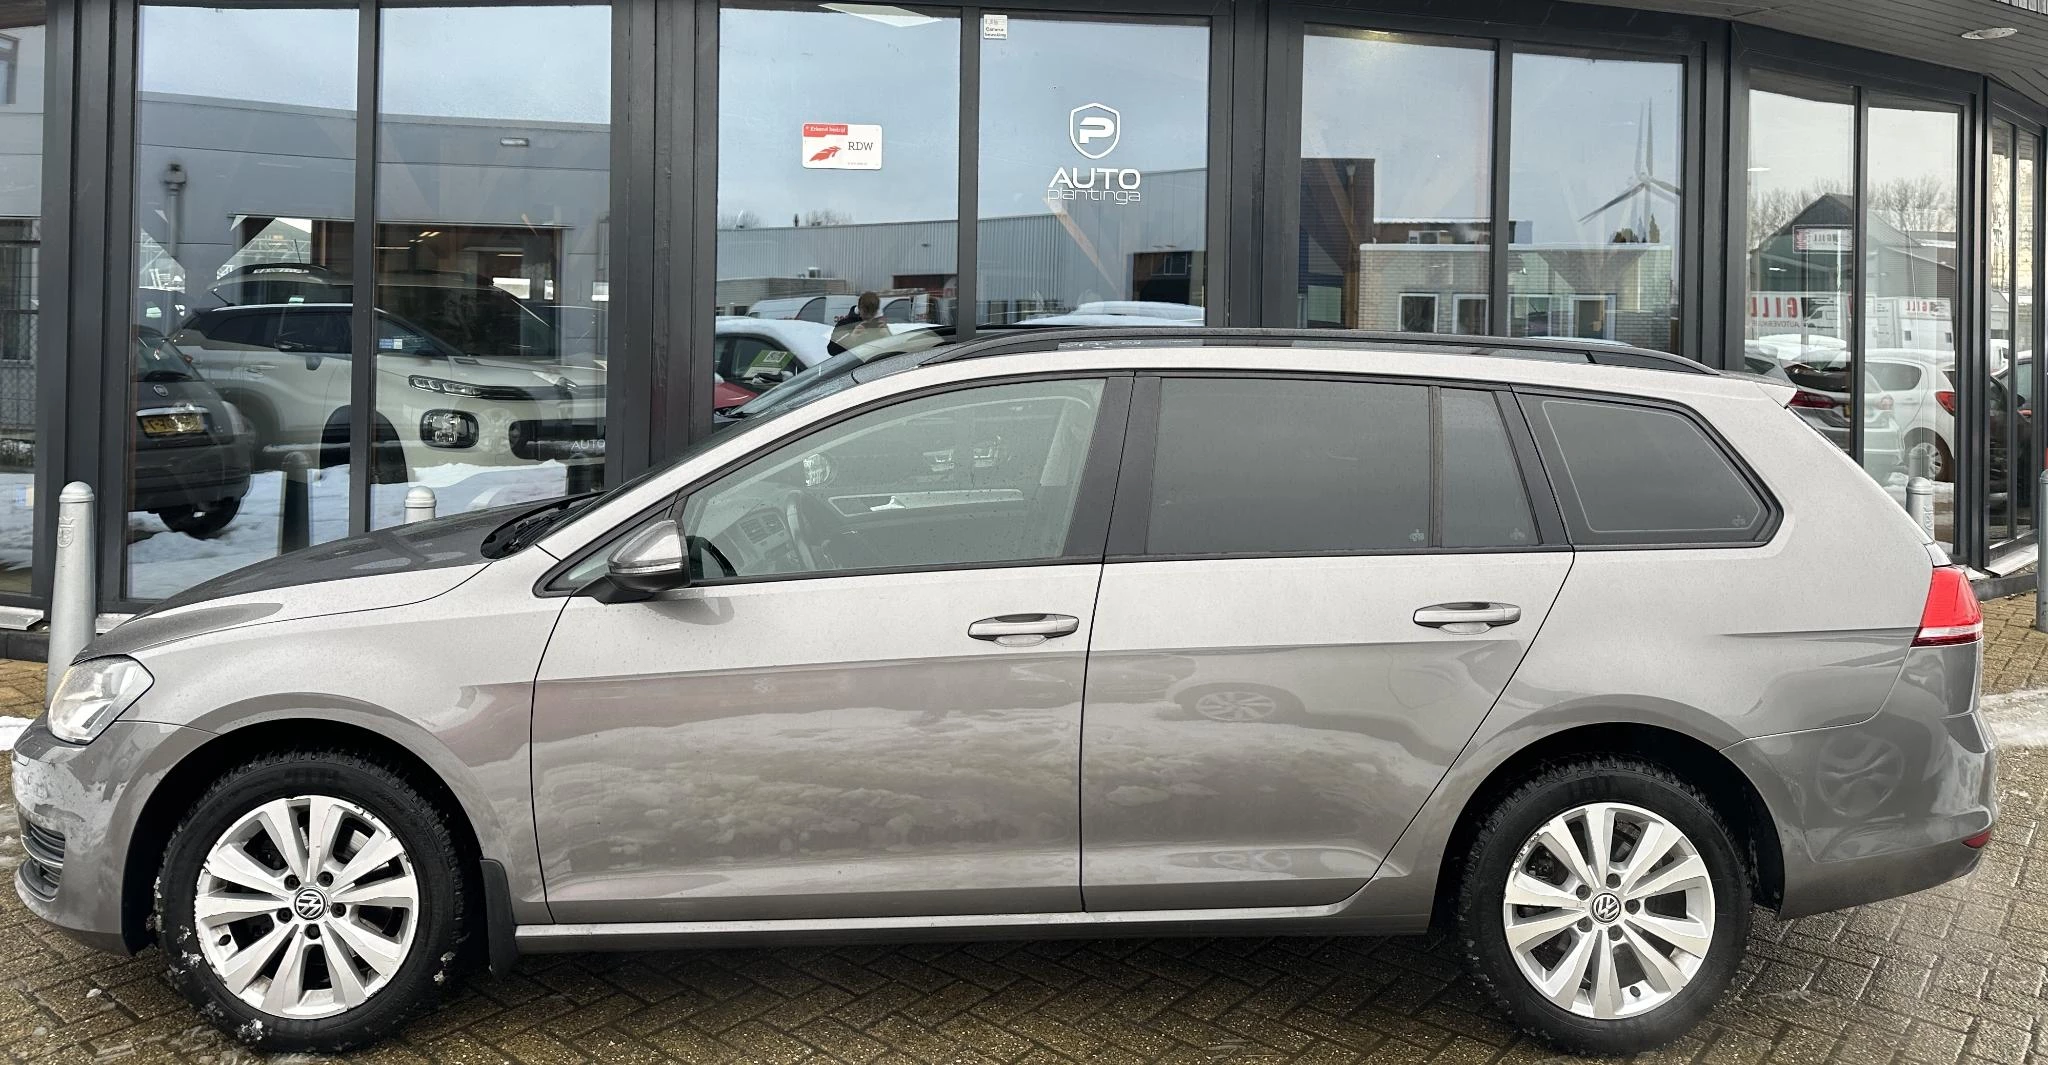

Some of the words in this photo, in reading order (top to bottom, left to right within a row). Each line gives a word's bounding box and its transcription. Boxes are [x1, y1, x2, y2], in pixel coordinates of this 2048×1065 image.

[1080, 117, 1115, 144] P
[848, 141, 874, 151] RDW
[1048, 167, 1141, 190] AUTO
[1047, 187, 1141, 205] plantinga
[570, 438, 605, 449] AUTO
